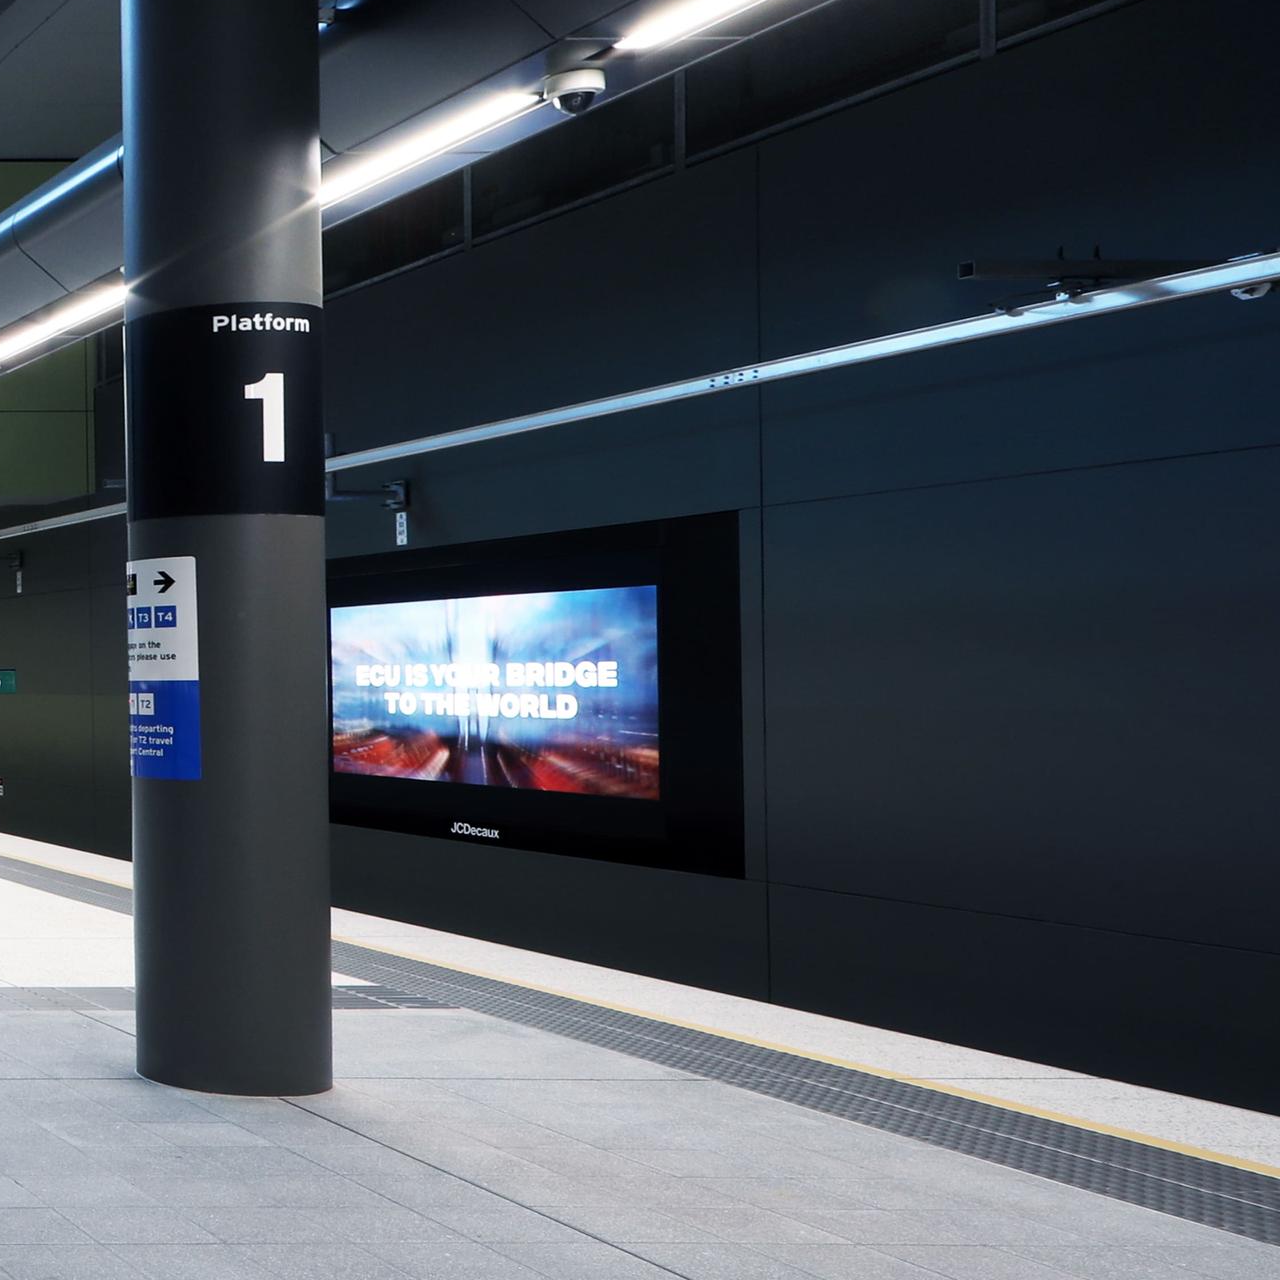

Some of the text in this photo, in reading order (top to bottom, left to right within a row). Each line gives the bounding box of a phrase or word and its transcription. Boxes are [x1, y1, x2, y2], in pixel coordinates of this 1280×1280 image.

[212, 312, 310, 333] Platform
[244, 372, 285, 463] 1
[137, 611, 173, 623] T3 T4
[147, 640, 161, 649] the
[136, 652, 158, 661] please
[159, 653, 177, 661] use
[355, 660, 618, 688] ECU IS YOR BRIDGE
[140, 699, 152, 709] T2
[384, 691, 578, 720] TO THE WORLD
[138, 724, 174, 735] departing
[138, 735, 148, 745] T2
[148, 736, 174, 745] travel
[138, 747, 164, 757] Central
[450, 821, 500, 839] JCDecaux
